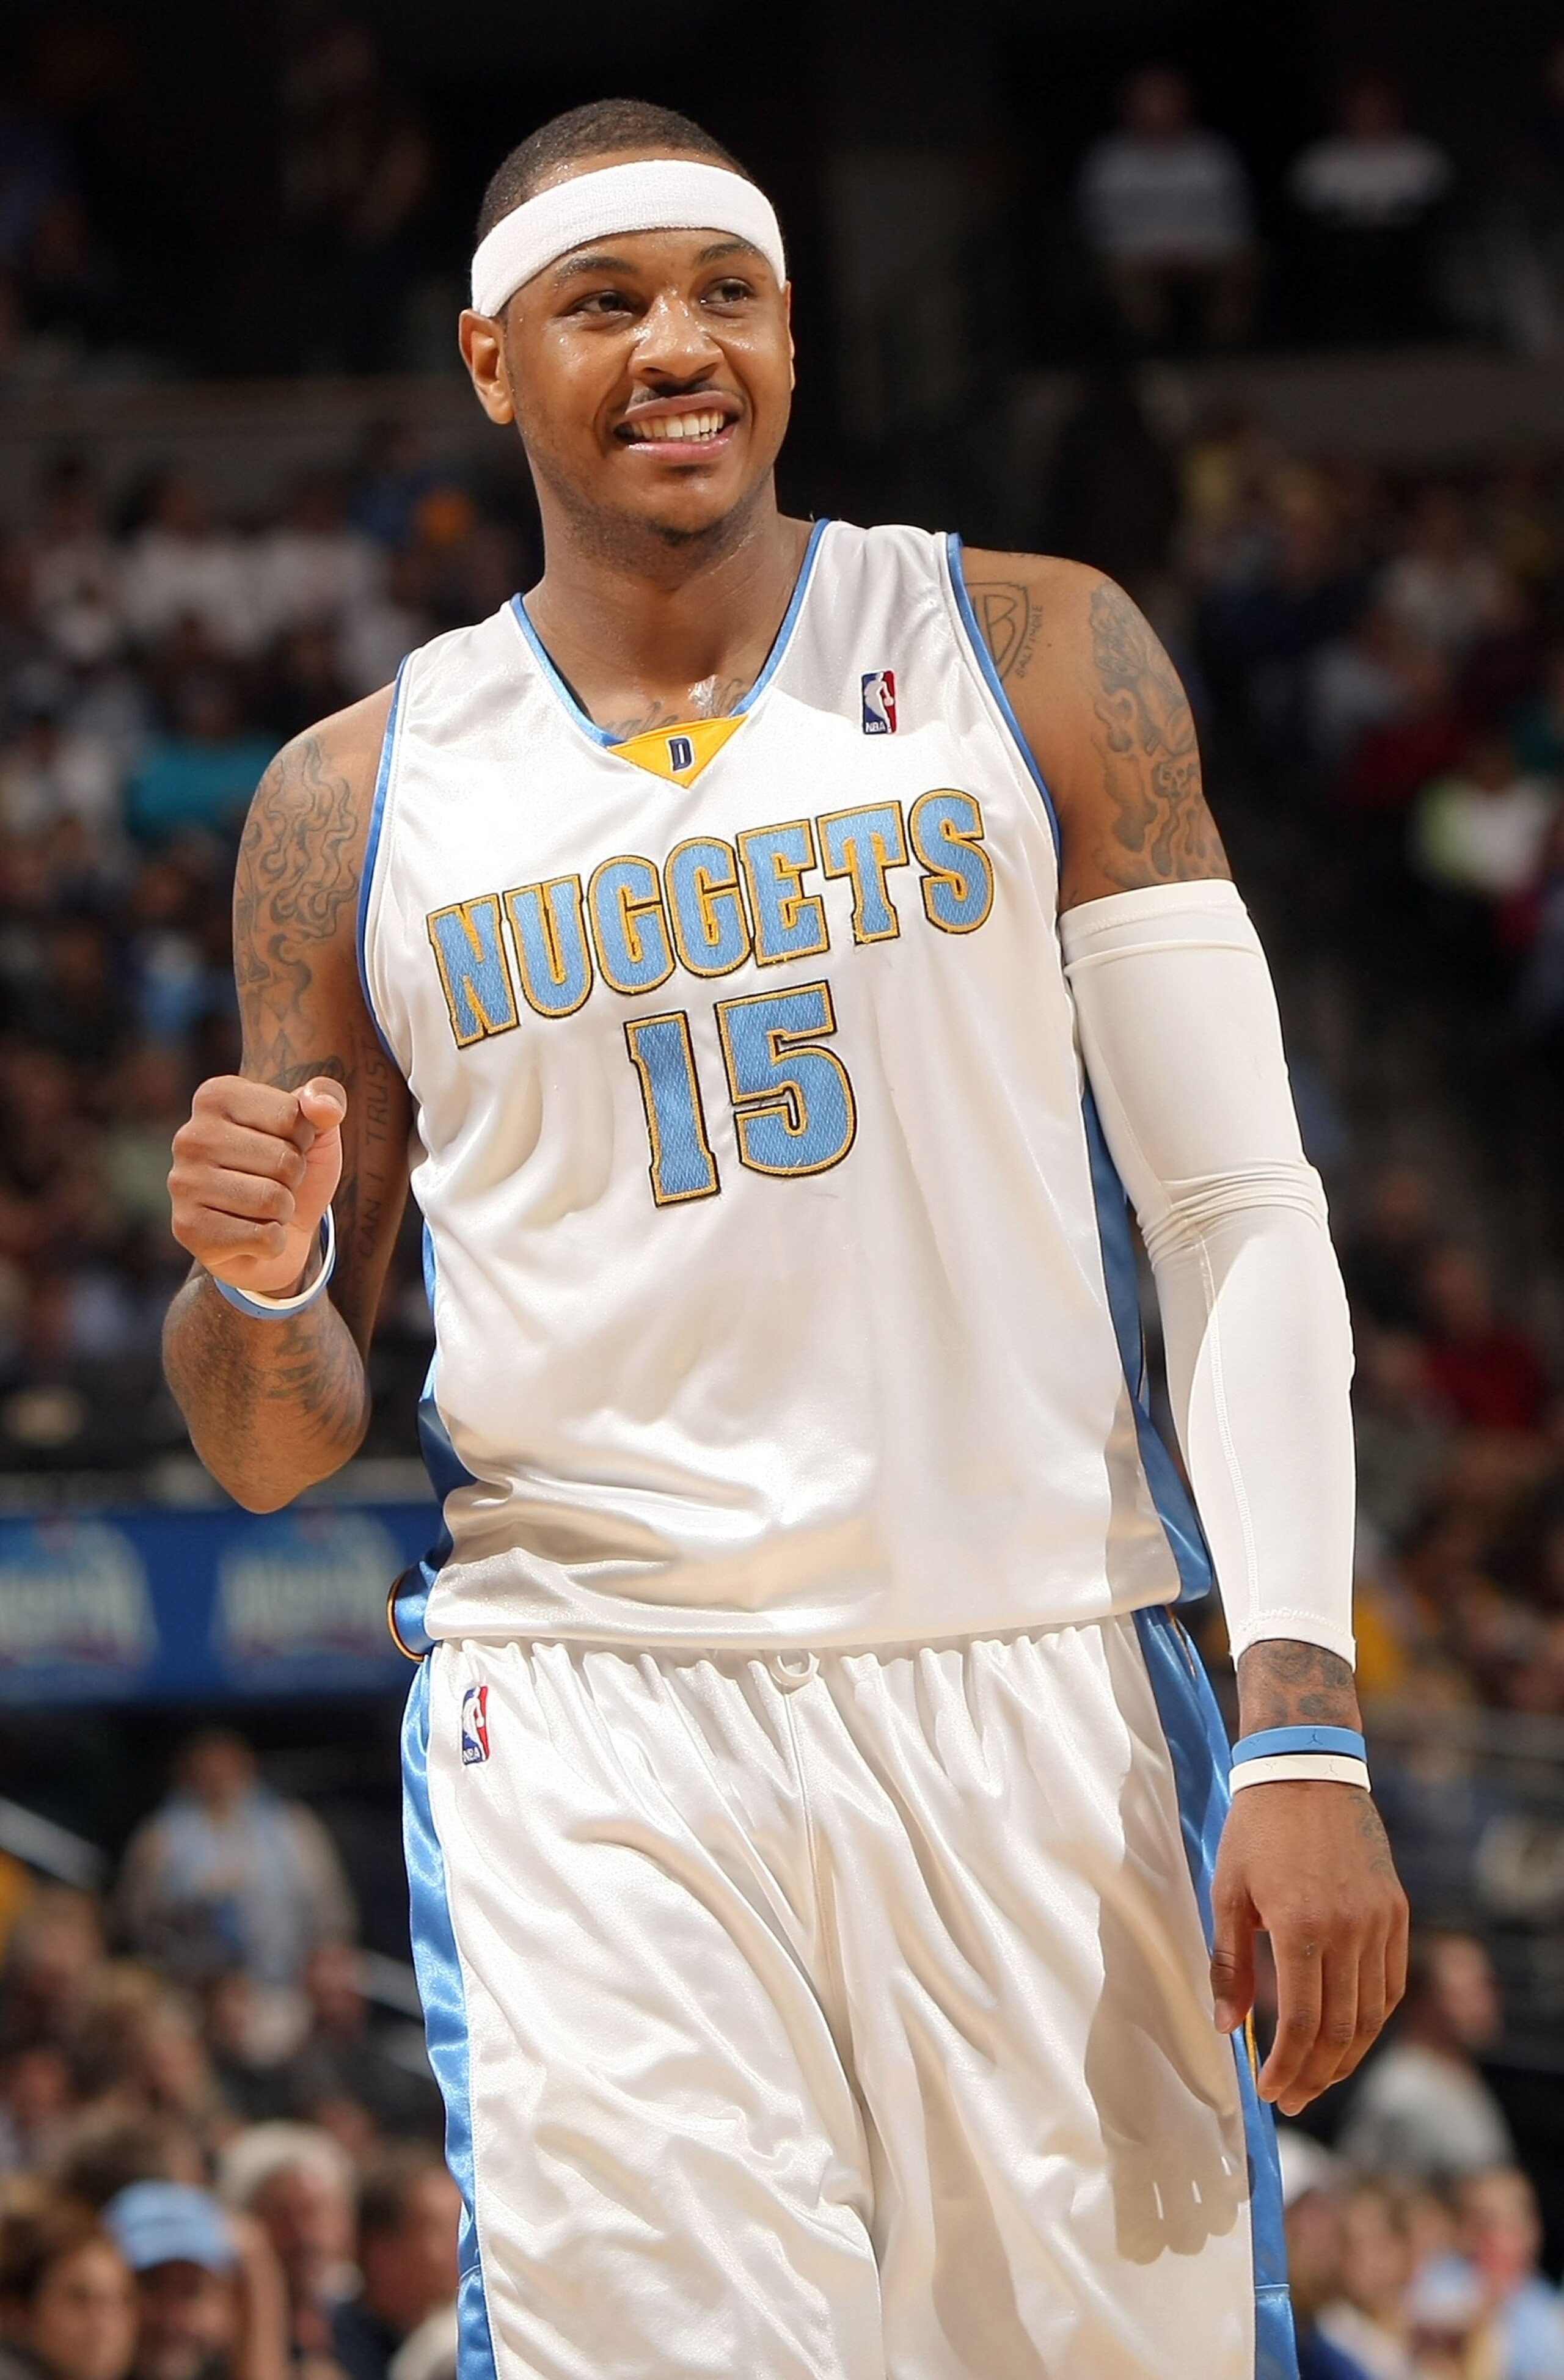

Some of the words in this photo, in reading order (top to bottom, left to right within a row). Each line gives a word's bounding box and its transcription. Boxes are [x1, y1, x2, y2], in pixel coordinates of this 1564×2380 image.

[668, 736, 693, 772] D
[865, 721, 886, 732] NBA
[426, 788, 994, 1049] NUGGETS
[624, 980, 857, 1208] 15
[358, 1197, 382, 1260] CAN
